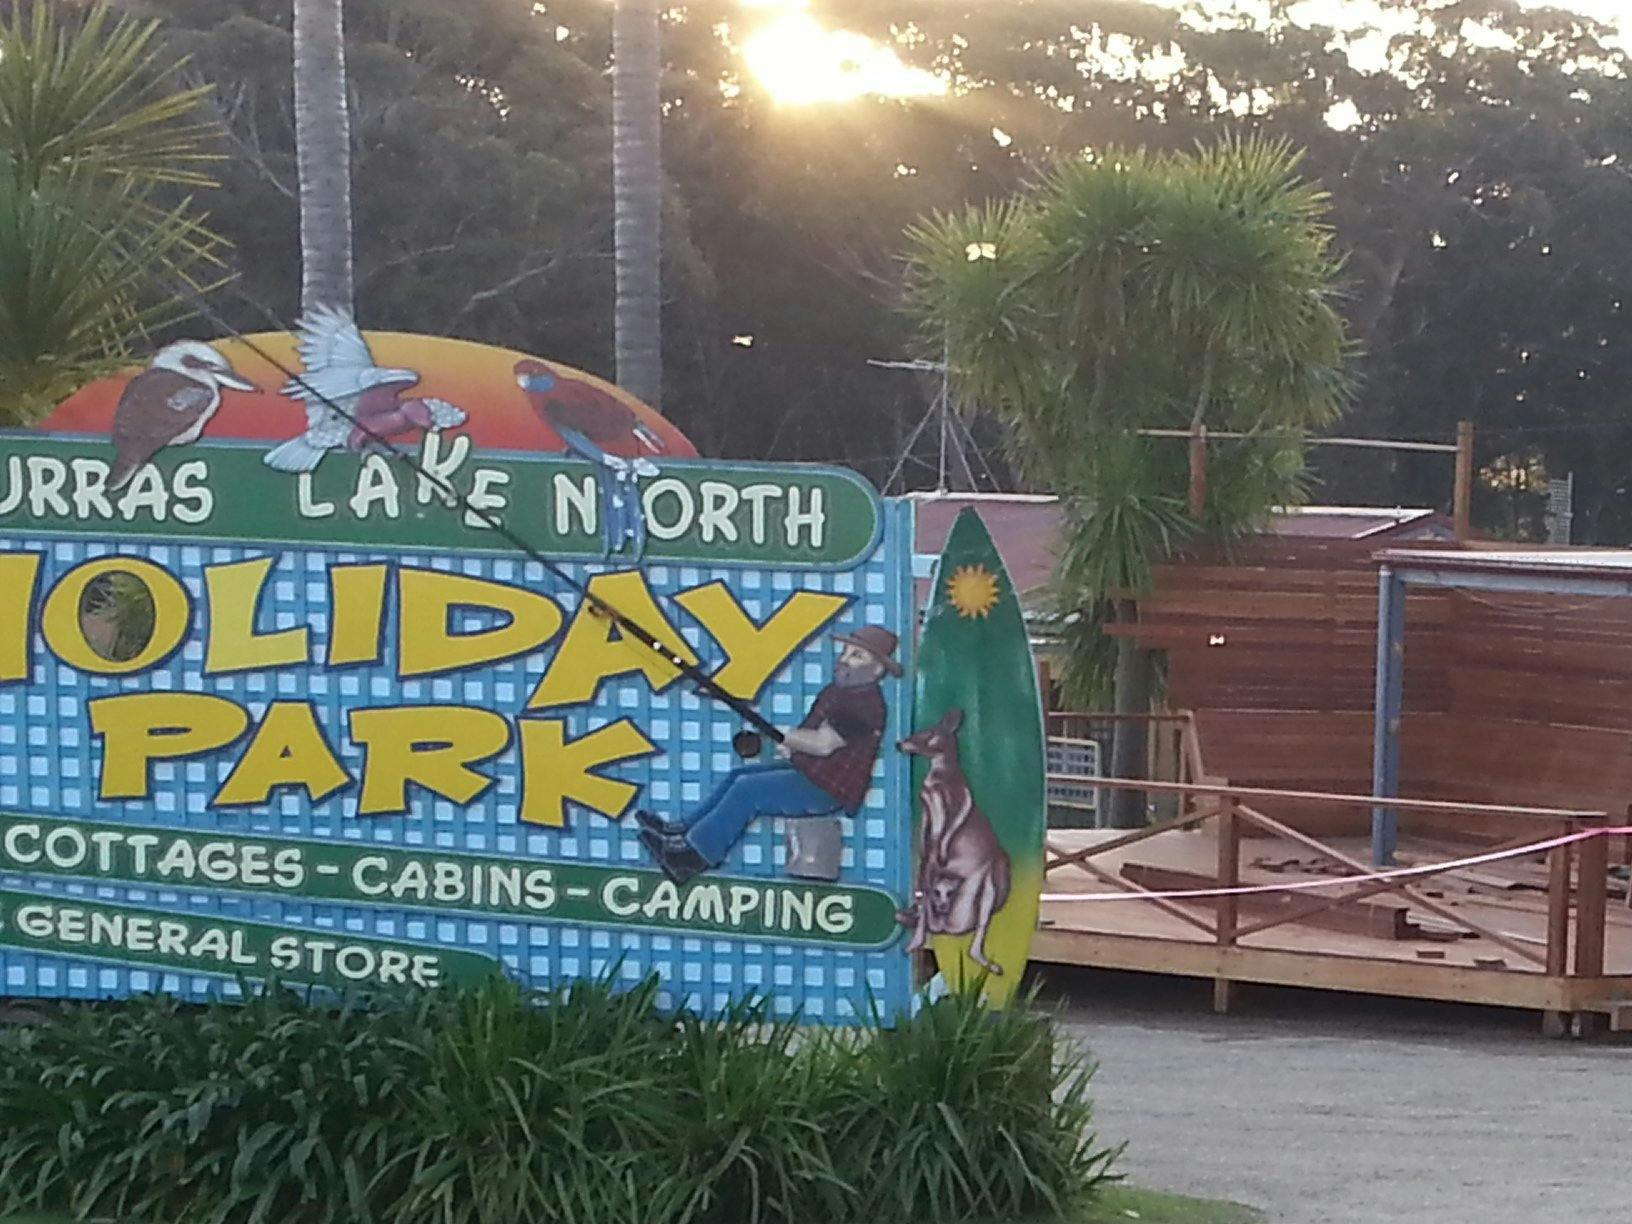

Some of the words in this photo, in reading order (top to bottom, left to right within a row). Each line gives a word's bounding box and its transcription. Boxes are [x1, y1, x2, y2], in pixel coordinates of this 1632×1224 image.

[298, 431, 510, 528] LAKE
[552, 472, 826, 549] NORTH
[88, 691, 660, 828] PARK
[4, 823, 304, 889] COTTAGES
[352, 856, 556, 910] CABINS
[601, 876, 854, 934] CAMPING
[16, 904, 257, 964] GENERAL
[270, 935, 441, 988] STORE
